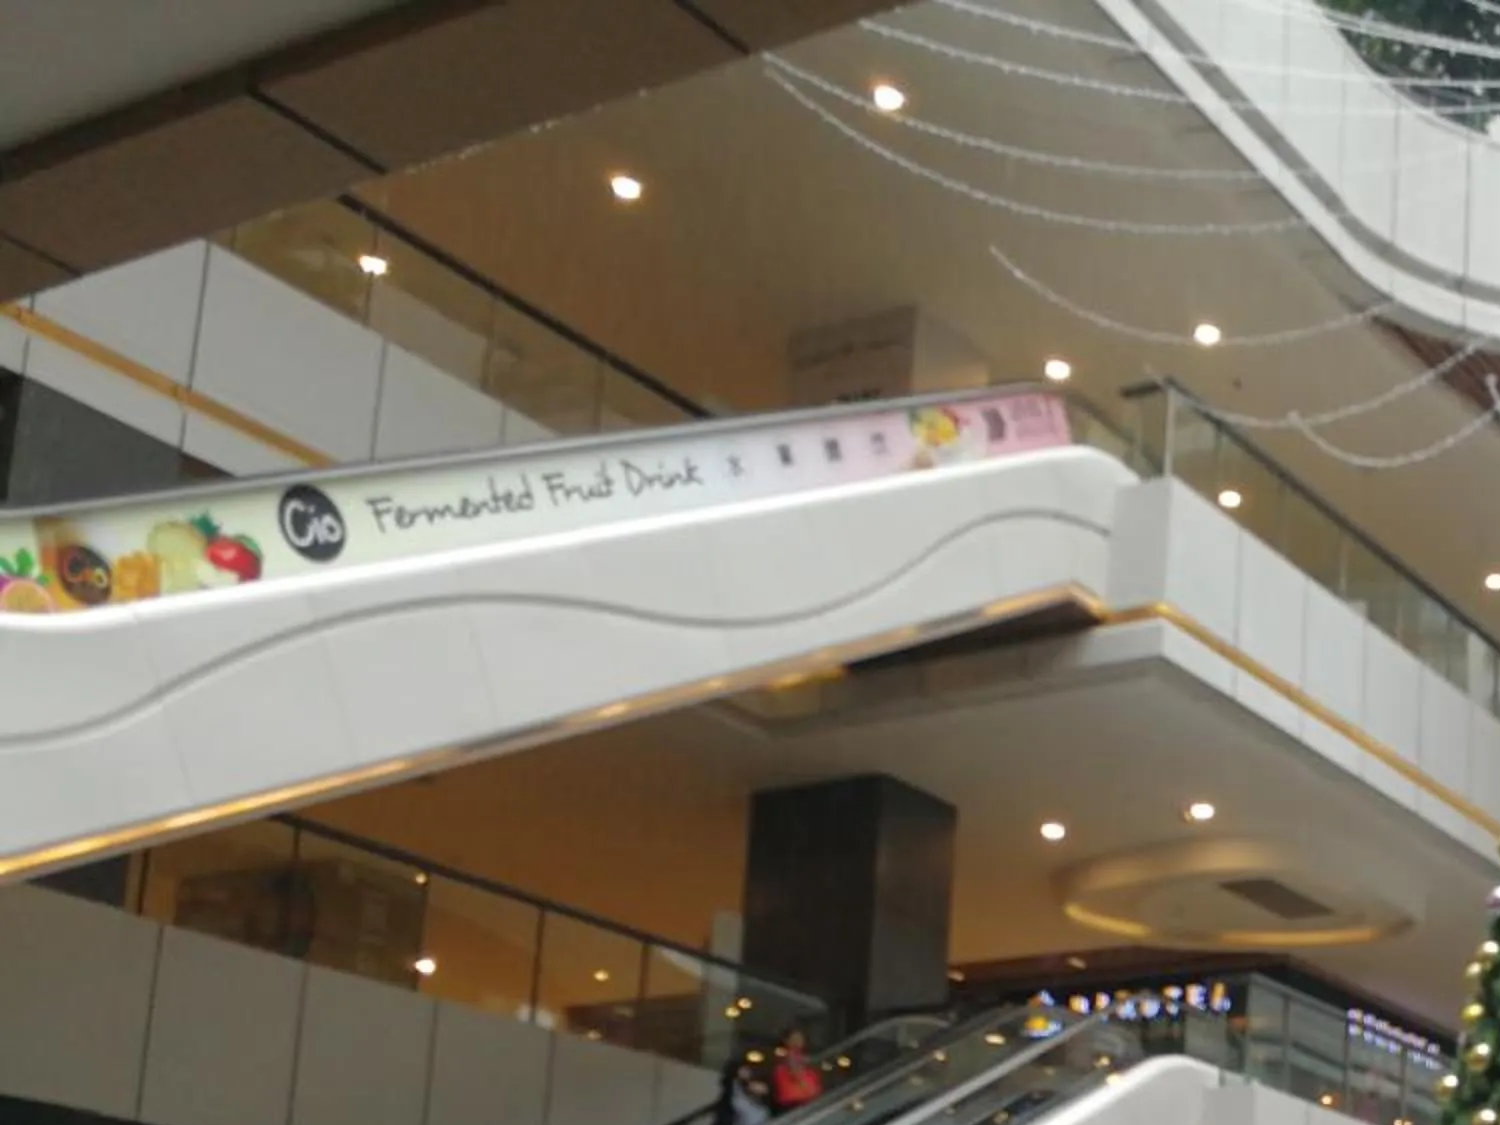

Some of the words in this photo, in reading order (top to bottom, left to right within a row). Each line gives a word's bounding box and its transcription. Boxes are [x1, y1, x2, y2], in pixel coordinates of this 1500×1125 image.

[366, 474, 535, 533] Fermented
[542, 460, 614, 505] Fruit
[621, 457, 704, 497] Drink
